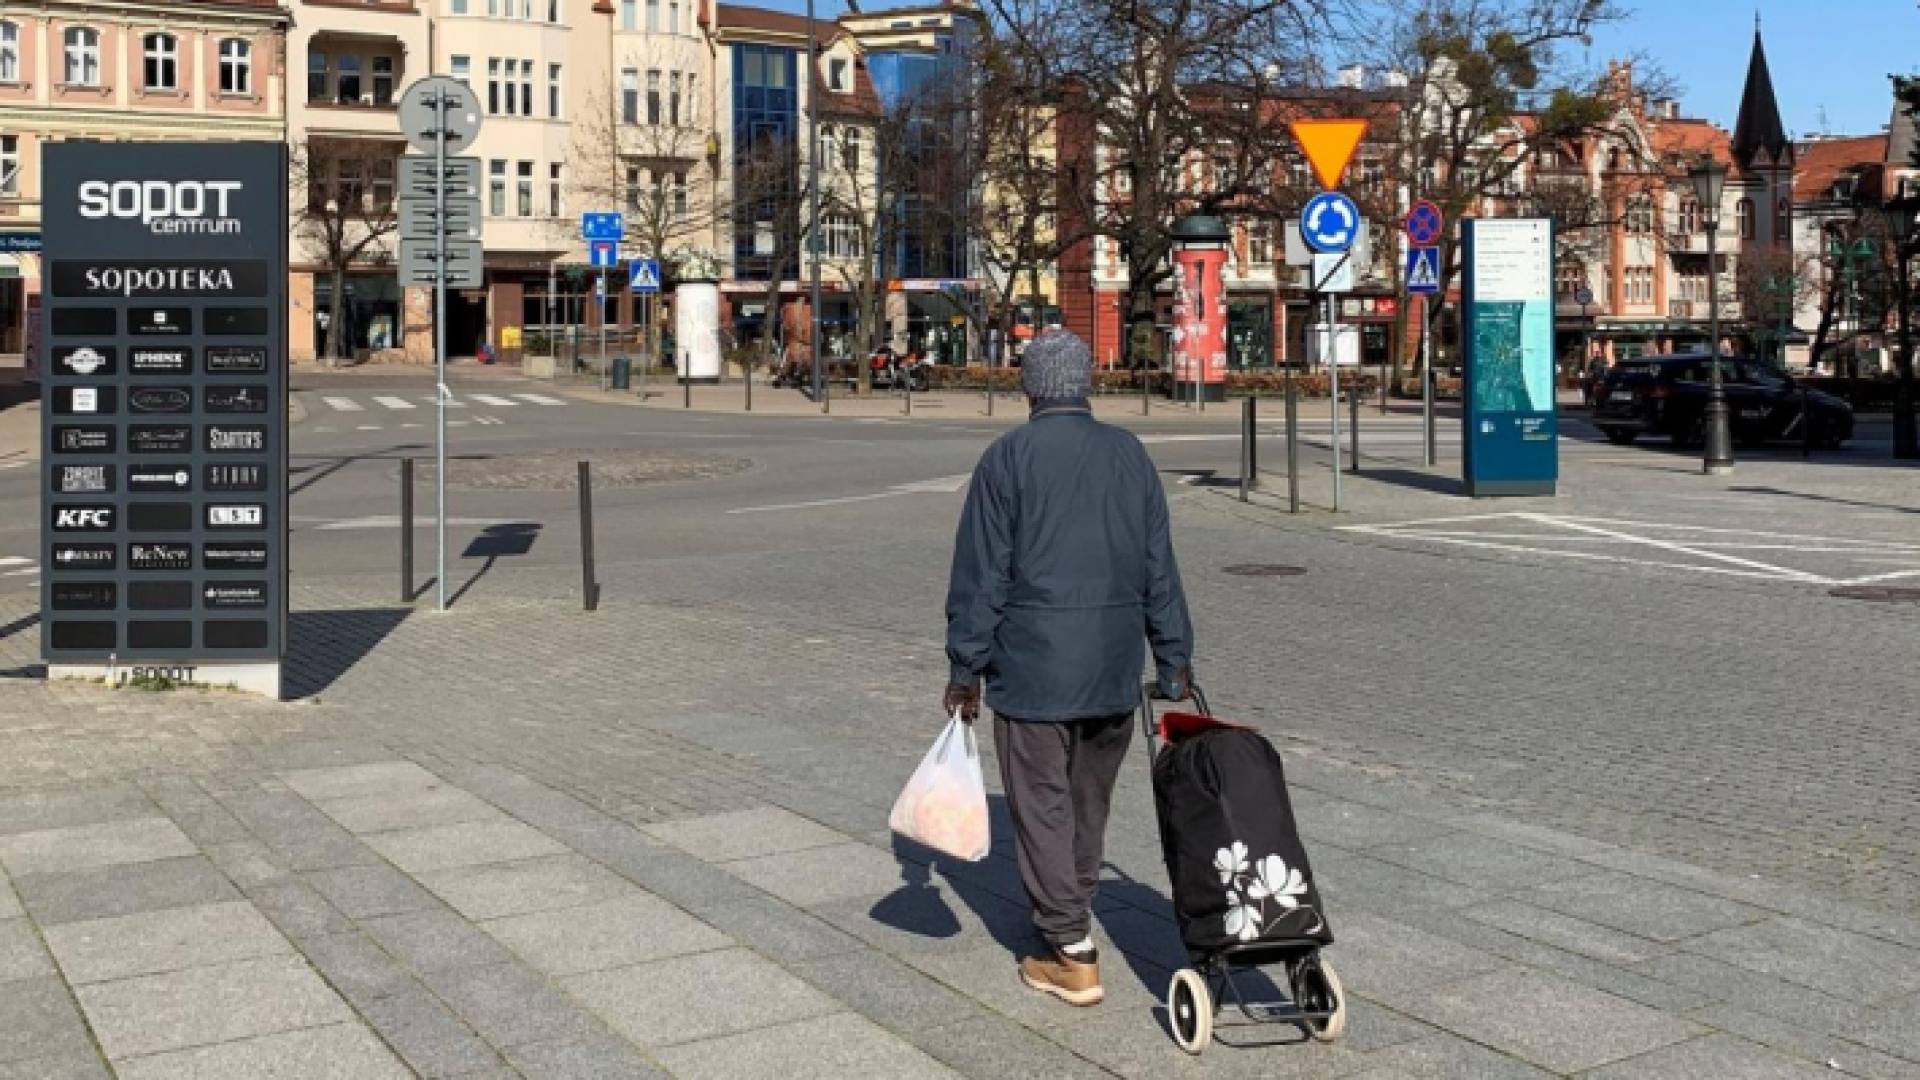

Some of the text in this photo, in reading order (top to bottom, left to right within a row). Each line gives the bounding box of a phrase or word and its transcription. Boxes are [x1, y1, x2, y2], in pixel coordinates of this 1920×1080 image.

[150, 217, 241, 235] centrum
[85, 266, 233, 297] SOPOTEKA
[56, 510, 111, 527] KFC
